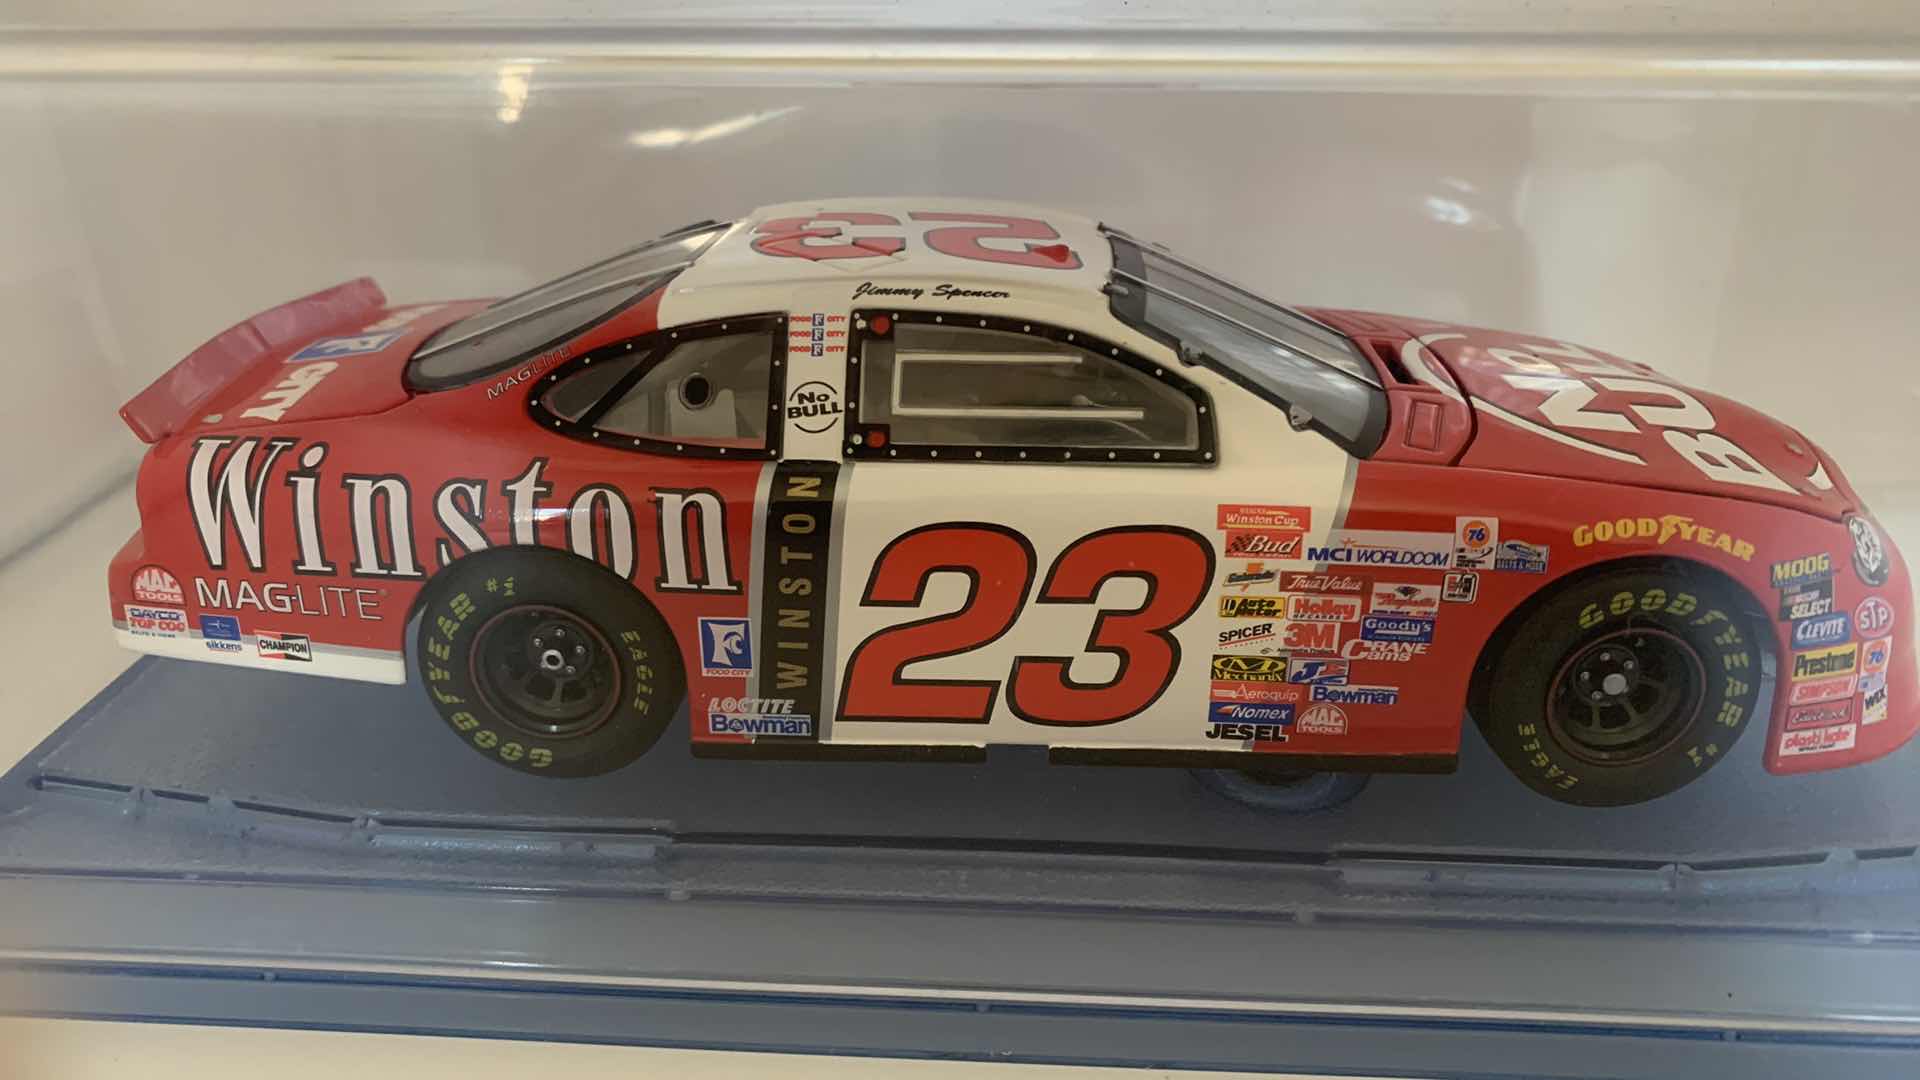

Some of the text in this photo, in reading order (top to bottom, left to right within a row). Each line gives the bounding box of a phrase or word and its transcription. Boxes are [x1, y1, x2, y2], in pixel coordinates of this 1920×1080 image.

[750, 210, 1083, 270] 23
[852, 282, 1010, 300] Jimmy Spencer
[797, 391, 831, 405] No
[787, 401, 843, 420] BULL
[186, 436, 746, 594] Winston
[1225, 513, 1299, 526] Winston Cup
[1246, 535, 1300, 554] Bud
[1467, 528, 1486, 542] 76
[1307, 547, 1352, 562] MCI
[1357, 550, 1449, 567] WORLDCOM
[1773, 555, 1831, 579] MOOG
[136, 568, 182, 593] MAC
[776, 476, 822, 689] WINSTON
[135, 592, 183, 602] TOOLS
[1294, 598, 1356, 618] Holley
[1790, 598, 1832, 620] SELECT
[1860, 599, 1888, 630] STP
[129, 618, 157, 630] TOP
[835, 521, 1217, 728] 23
[1218, 623, 1273, 643] SPICER
[1365, 618, 1433, 633] Goody's
[1282, 622, 1336, 648] 3M
[206, 641, 243, 651] sikkens
[259, 639, 308, 654] CHAMPION
[620, 629, 654, 715] EAGLE
[705, 669, 731, 677] FOOD
[1235, 684, 1300, 702] Aeroquip
[1313, 686, 1398, 705] Bowman
[707, 698, 796, 714] LOCTITE
[1231, 705, 1290, 720] Nomex
[710, 714, 812, 734] Bowman
[1302, 707, 1344, 726] MAC
[1206, 724, 1289, 742] JESEL
[1518, 722, 1580, 790] EAGLE
